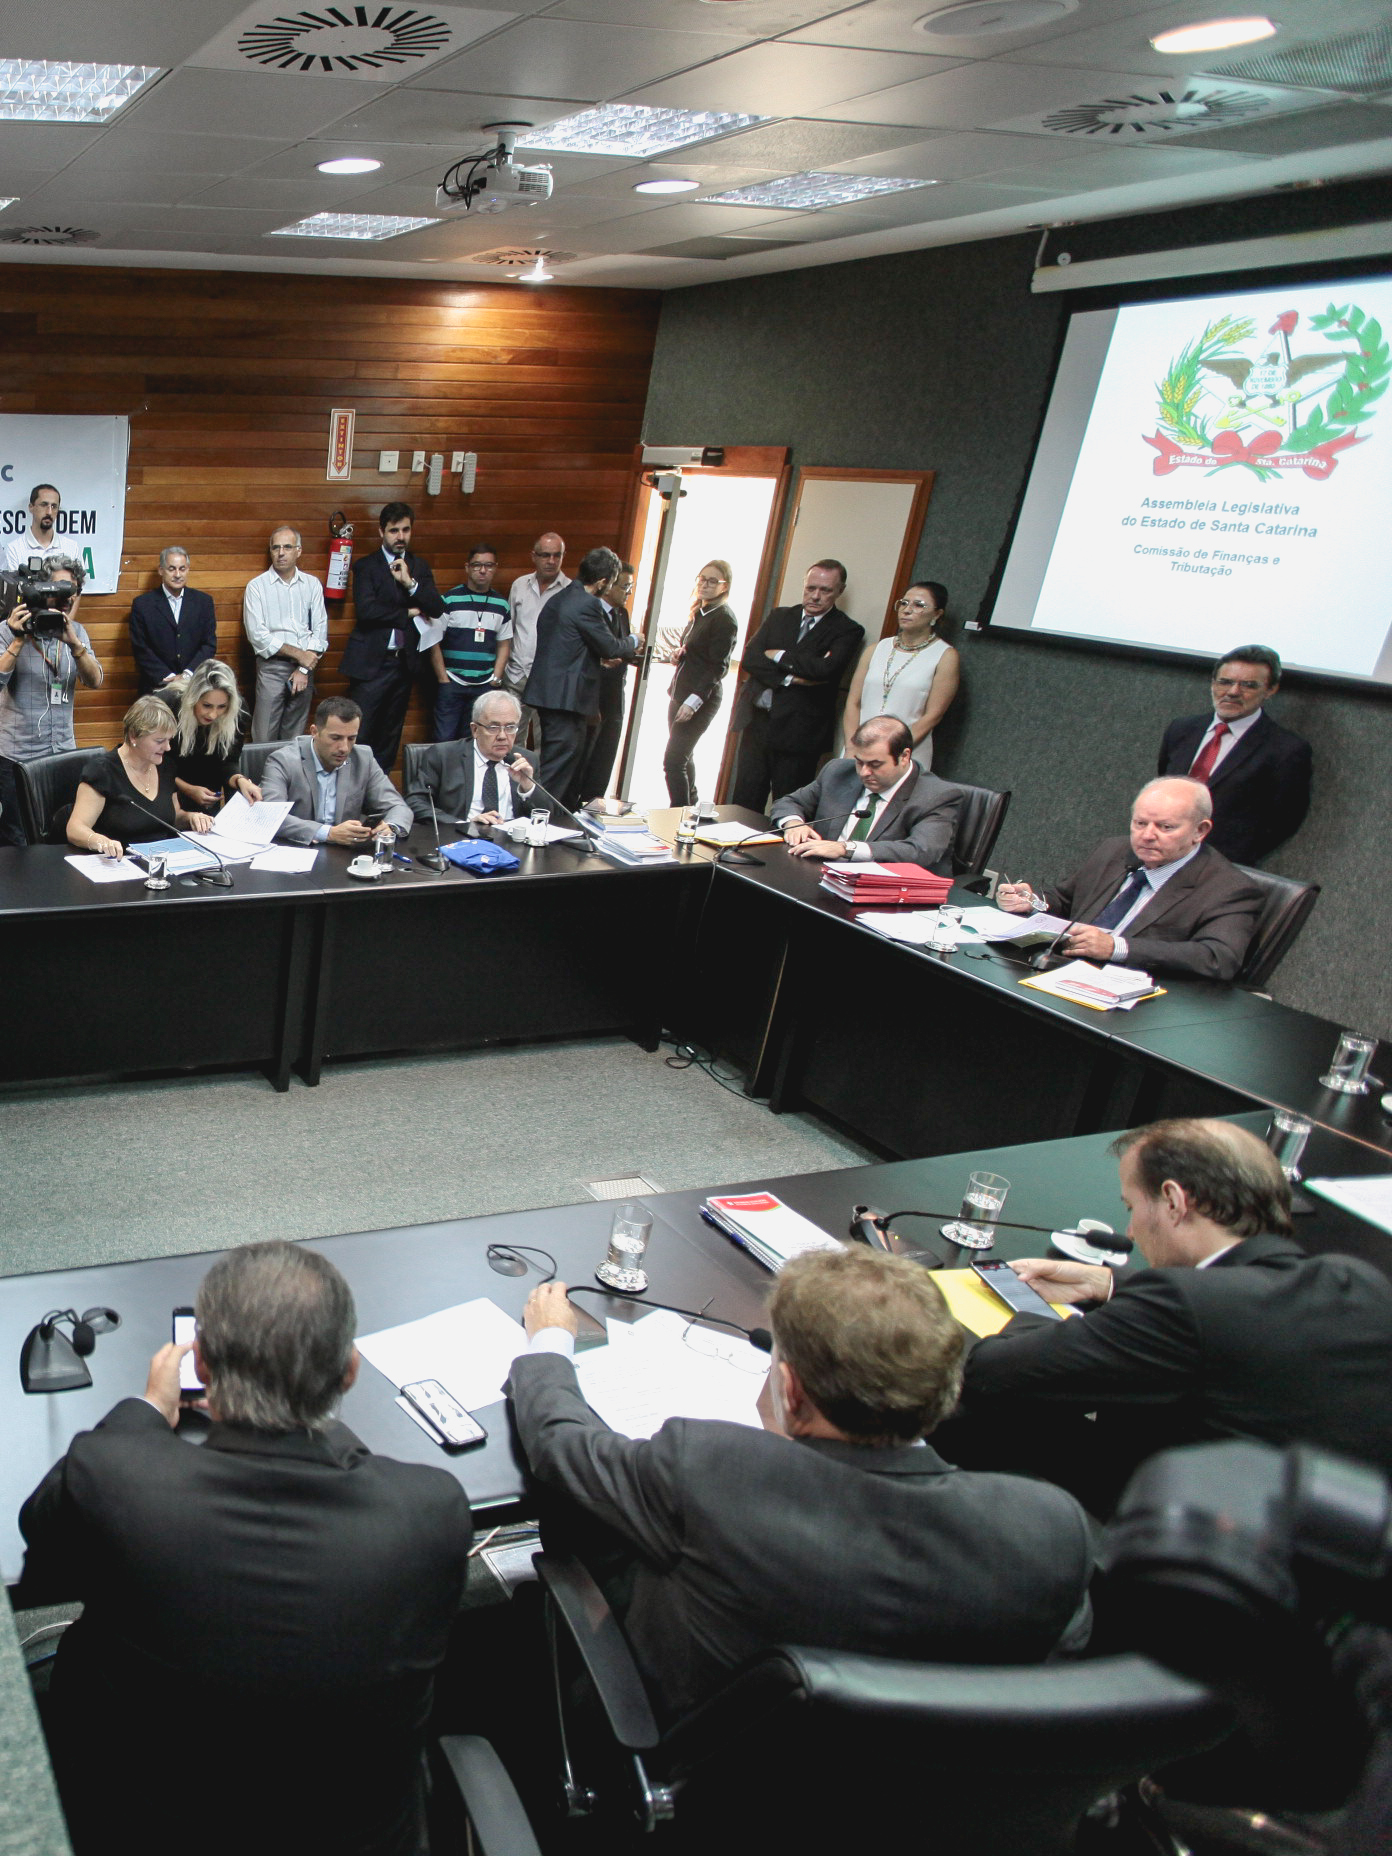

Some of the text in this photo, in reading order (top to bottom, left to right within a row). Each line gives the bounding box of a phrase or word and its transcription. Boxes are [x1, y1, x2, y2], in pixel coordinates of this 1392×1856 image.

[337, 418, 346, 467] EXTINTOR
[1169, 455, 1203, 465] Estado
[1140, 497, 1300, 516] Assembleia Legislativa
[1121, 515, 1318, 538] do Estado de Santa Catarina
[1133, 544, 1280, 565] Comissão de Finanças e
[1170, 561, 1233, 577] Tributação
